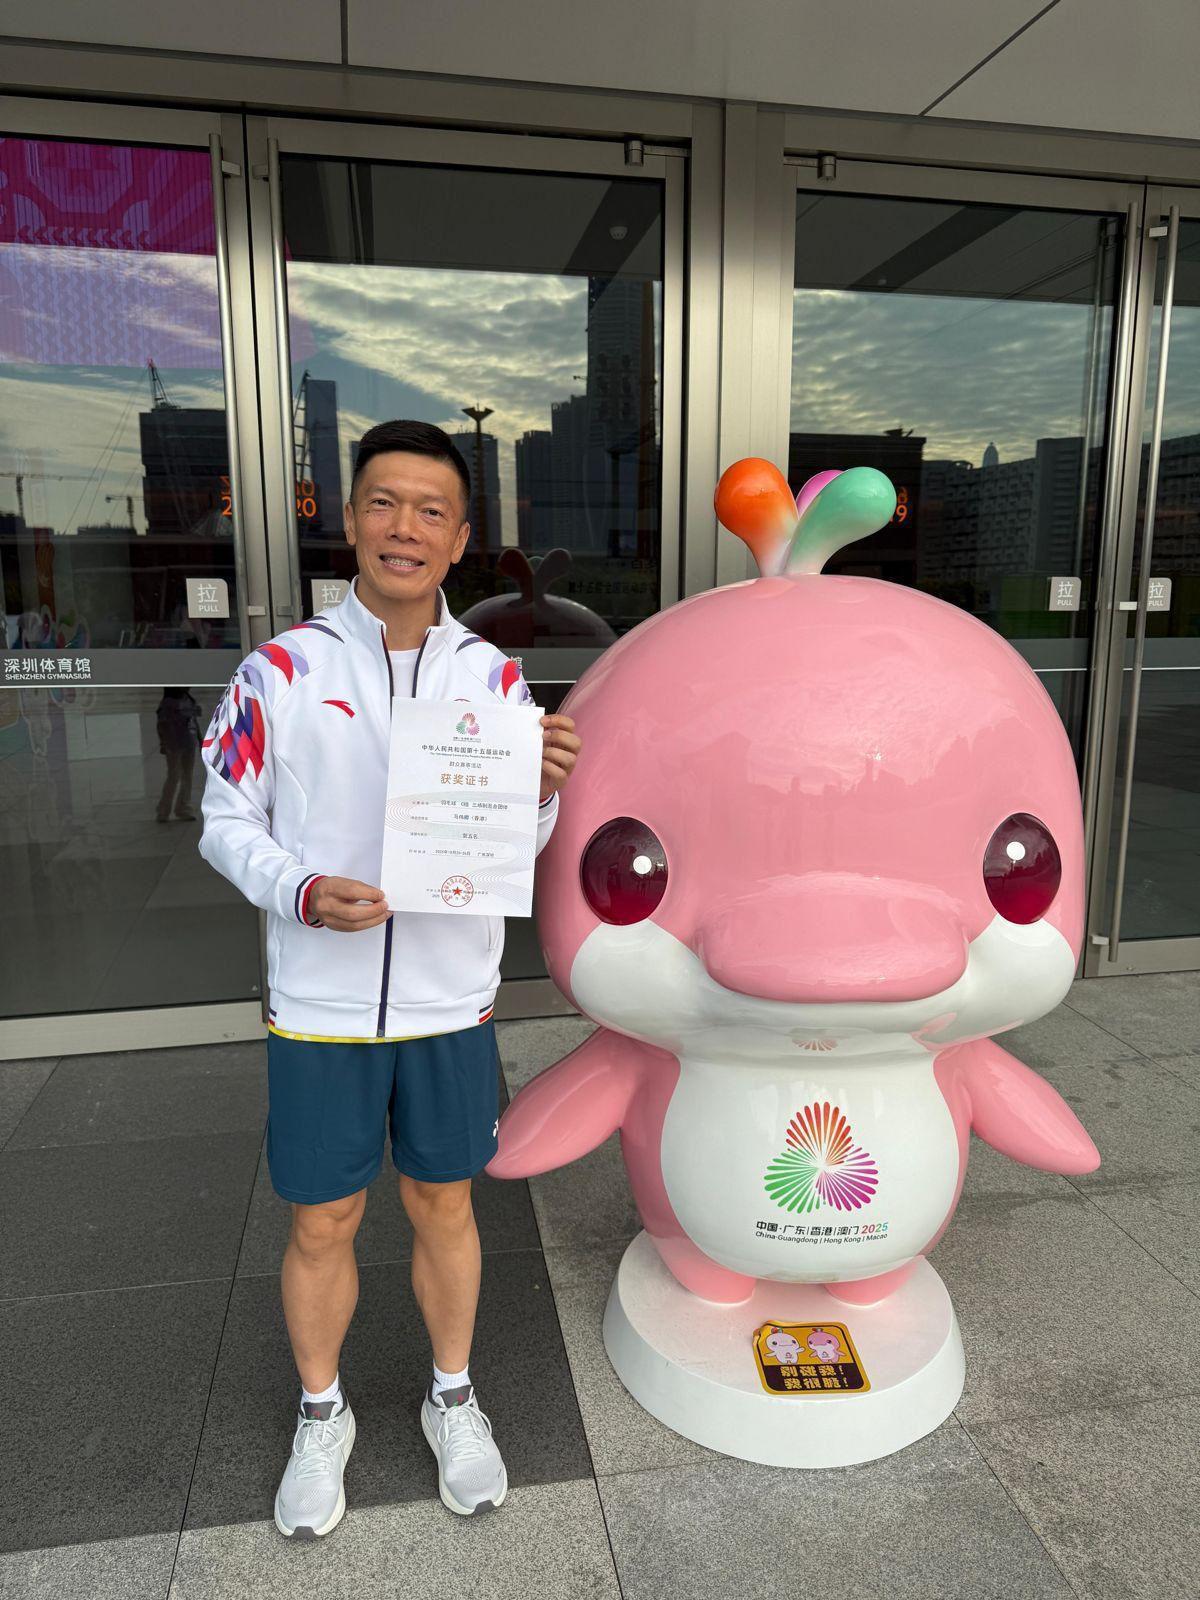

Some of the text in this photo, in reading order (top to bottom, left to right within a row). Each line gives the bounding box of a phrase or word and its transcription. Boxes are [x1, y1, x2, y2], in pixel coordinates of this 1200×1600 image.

[197, 583, 218, 603] 拉
[321, 584, 342, 604] 拉
[1057, 580, 1073, 598] 拉
[1148, 581, 1164, 599] 拉
[198, 605, 219, 613] PULL
[1057, 599, 1072, 607] PULL
[1147, 600, 1163, 608] PULL
[4, 657, 91, 673] 深圳体育馆
[5, 672, 92, 681] SHENZHEN GYMNASIUM
[422, 744, 512, 757] 中华人民共和国第十五届运动会
[440, 772, 489, 787] 获奖证书
[861, 1221, 889, 1235] 2025
[823, 1236, 843, 1245] Hong
[843, 1235, 862, 1244] Kong
[865, 1232, 888, 1242] Macao
